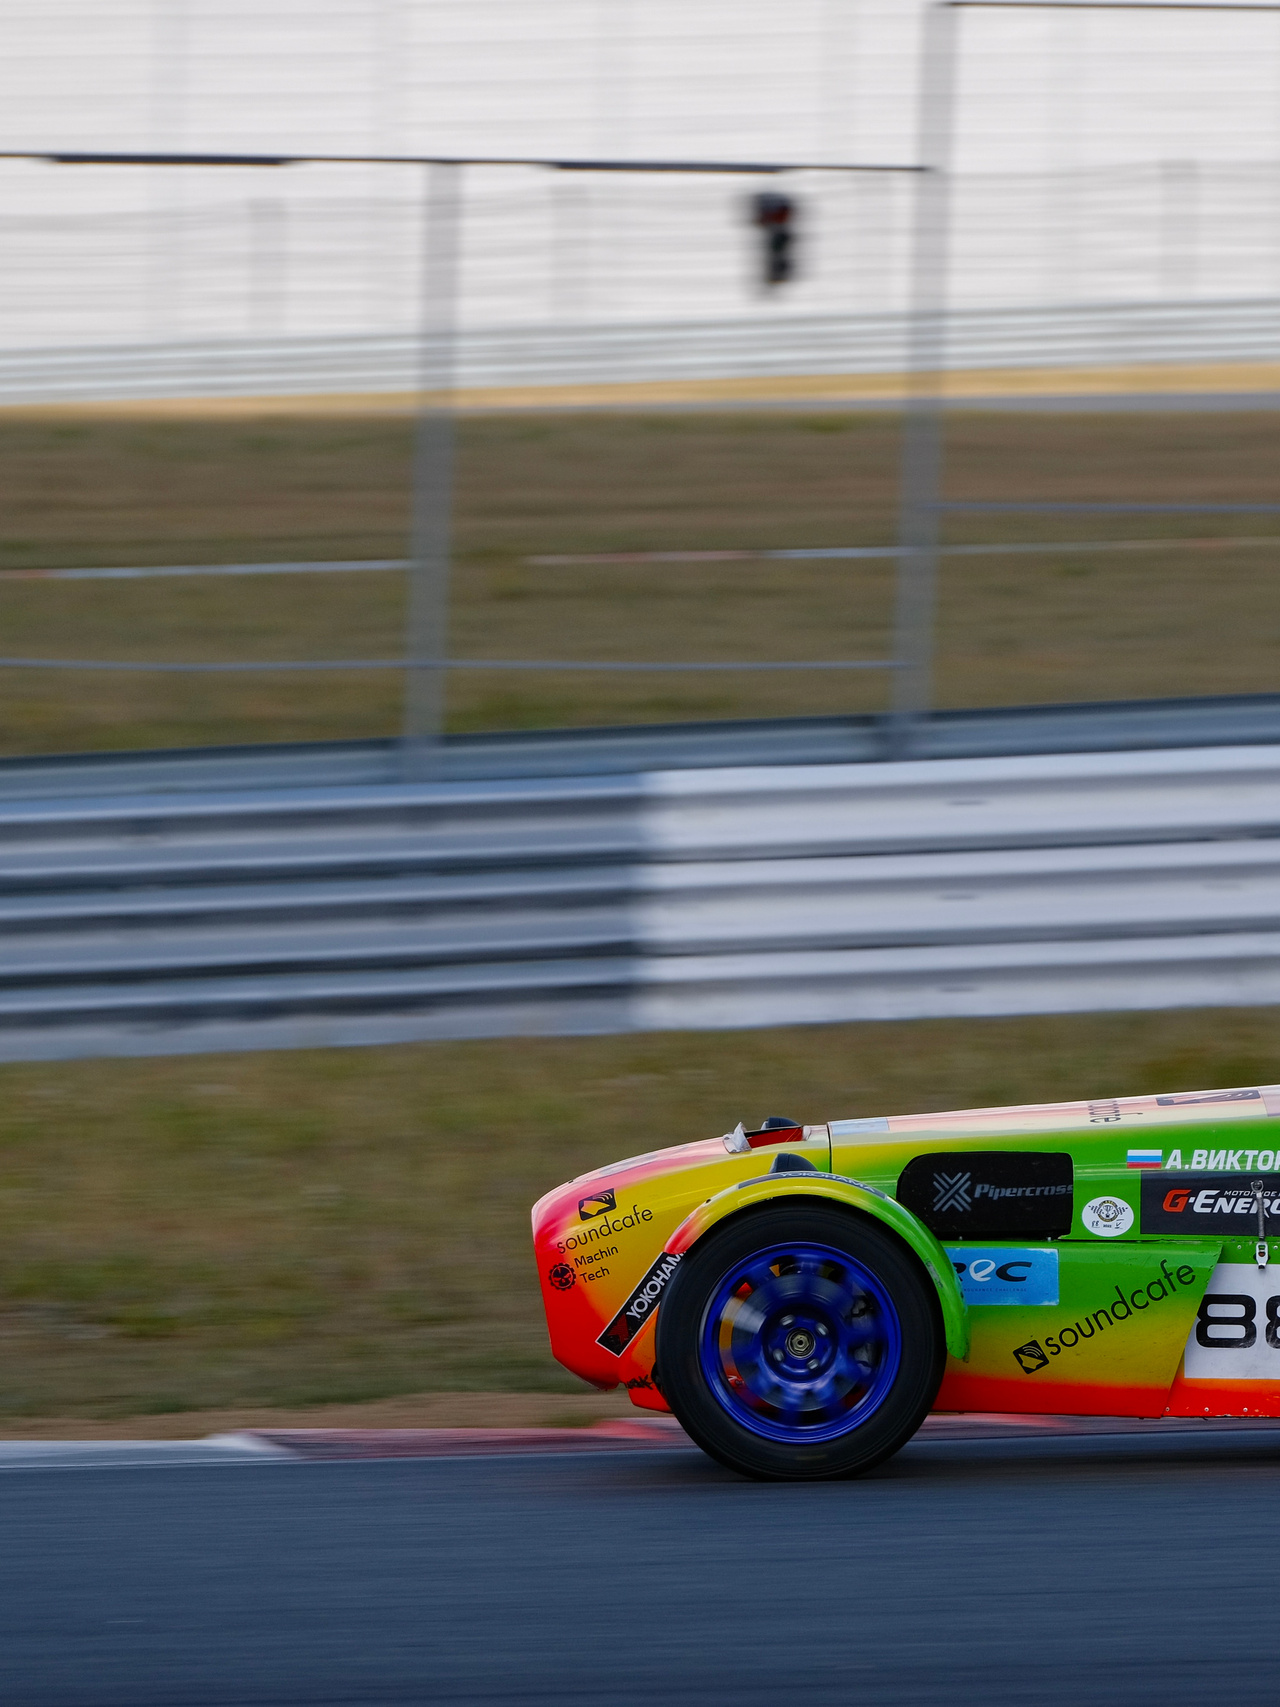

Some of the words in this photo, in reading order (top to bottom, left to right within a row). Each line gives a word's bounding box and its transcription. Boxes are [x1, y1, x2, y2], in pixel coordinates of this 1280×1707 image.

[779, 1172, 876, 1193] YOKOHAMA
[973, 1183, 1074, 1201] Pipercross
[556, 1204, 654, 1254] soundcafe
[573, 1245, 619, 1269] Machin
[579, 1266, 610, 1283] Tech
[626, 1251, 684, 1319] YOKOHAM
[1044, 1259, 1197, 1356] soundcafe
